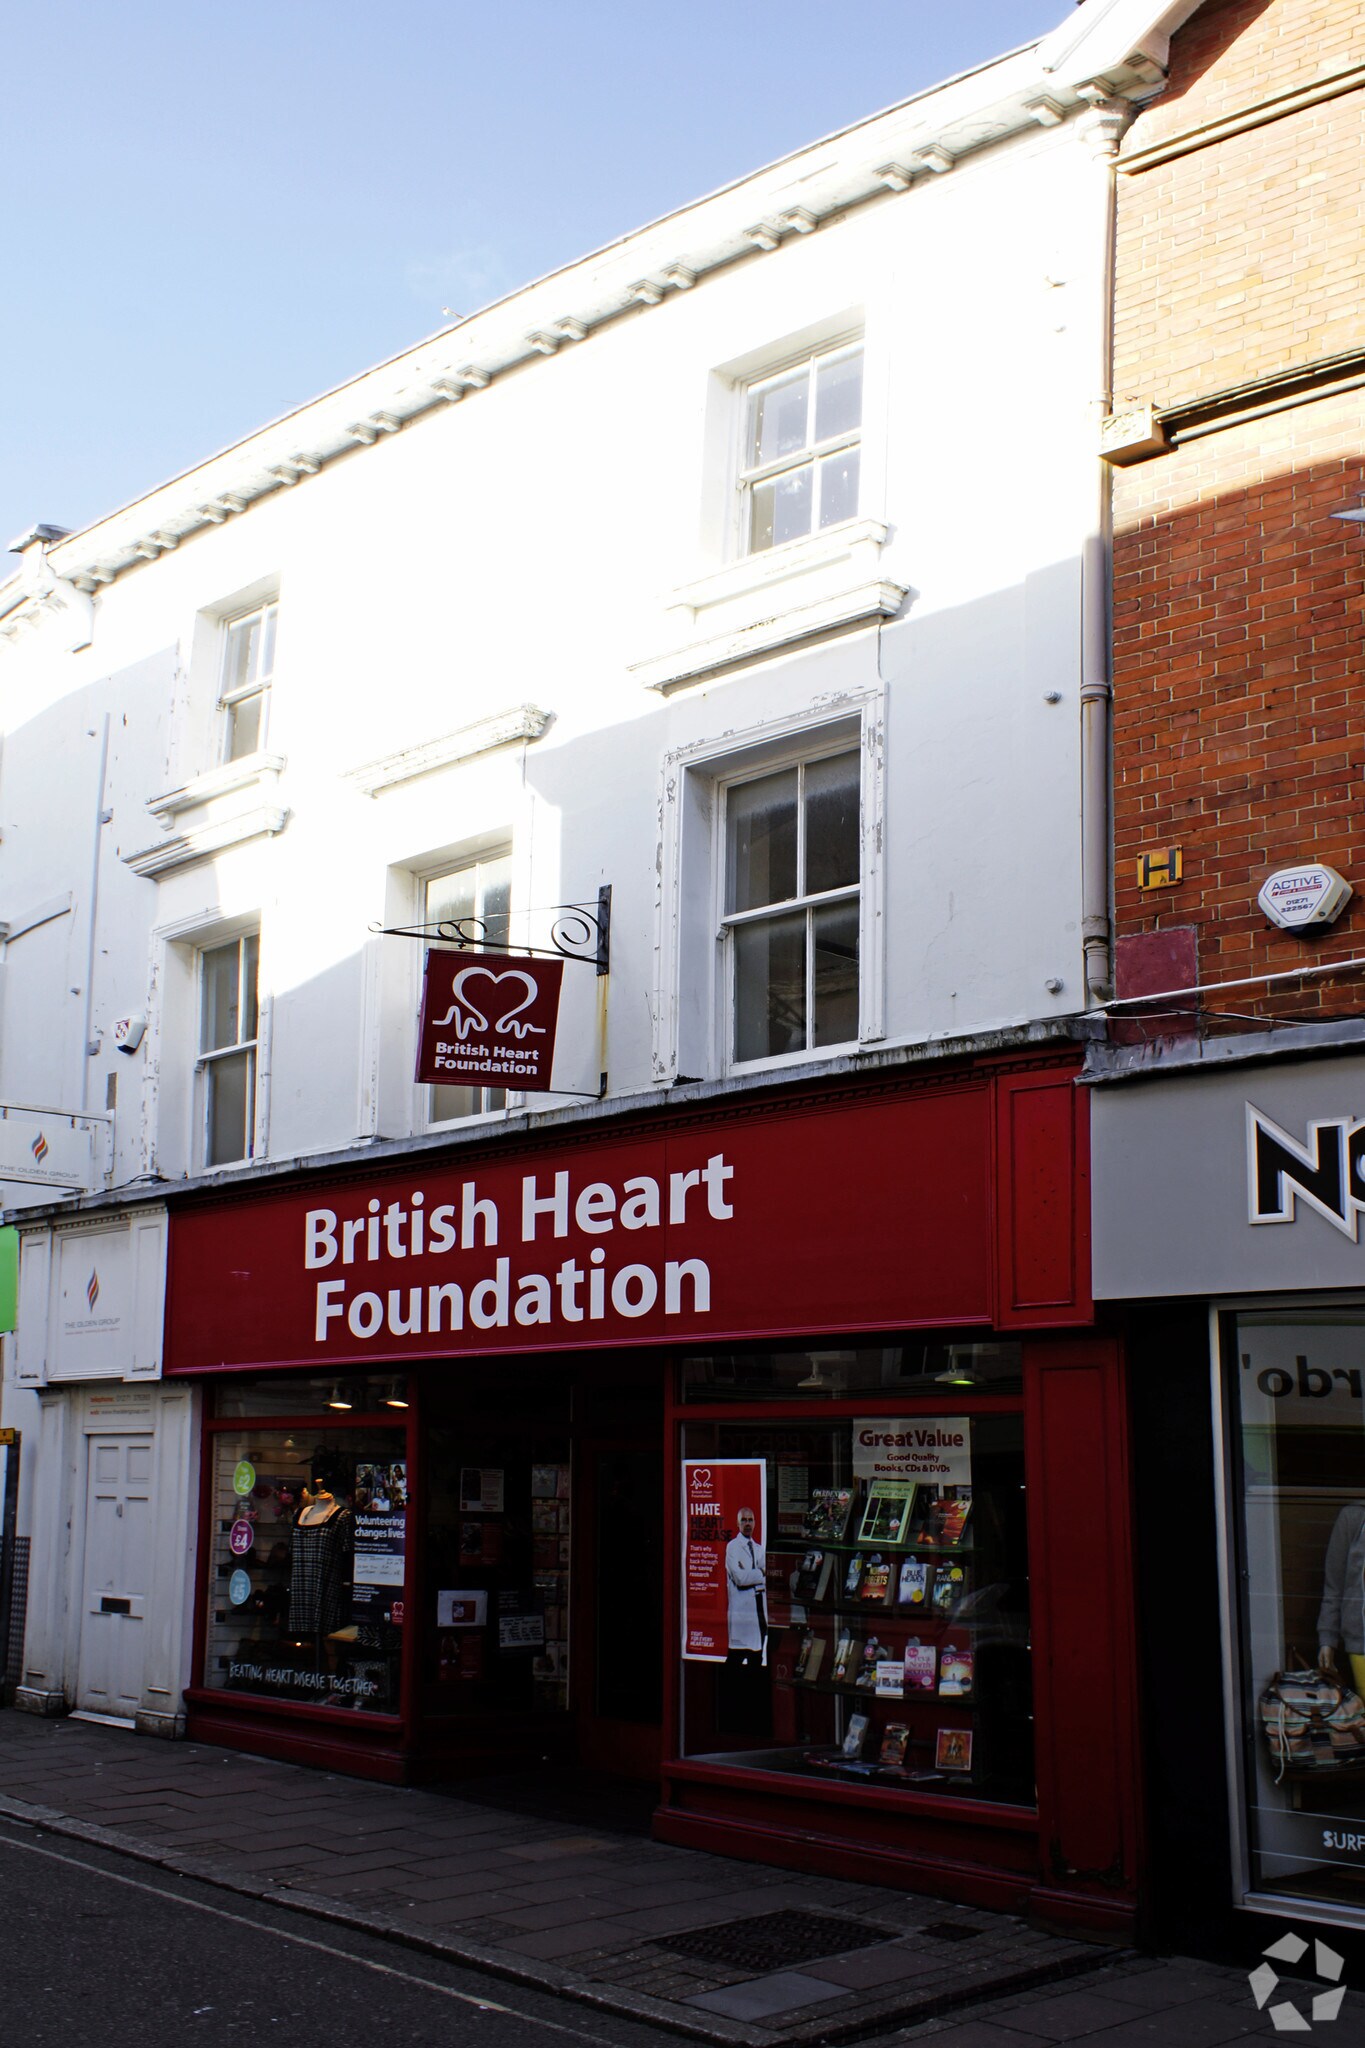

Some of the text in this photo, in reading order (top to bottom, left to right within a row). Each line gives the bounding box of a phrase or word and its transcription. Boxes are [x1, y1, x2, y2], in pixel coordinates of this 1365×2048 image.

[1143, 849, 1176, 886] H
[1271, 874, 1322, 892] ACTIVE
[1281, 903, 1314, 913] 322567
[1286, 897, 1308, 905] 01271
[435, 1042, 539, 1060] British Heart
[434, 1056, 538, 1075] Foundation
[18, 1167, 47, 1175] OLDEN
[49, 1171, 80, 1179] GROUP
[305, 1153, 734, 1269] British Heart
[315, 1247, 710, 1341] Foundation
[859, 1430, 913, 1447] Great
[915, 1430, 964, 1447] Value
[887, 1453, 940, 1463] Good Quality
[874, 1464, 904, 1473] Books,
[905, 1464, 921, 1473] CDs
[922, 1465, 929, 1473] &
[237, 1474, 251, 1490] £2
[690, 1503, 721, 1515] I HATE
[355, 1515, 405, 1529] Volunteering
[691, 1516, 724, 1528] HEART
[234, 1533, 248, 1550] £4
[354, 1527, 405, 1540] changes lives
[690, 1529, 733, 1541] DISEASE
[901, 1575, 925, 1583] HEAVEN
[233, 1584, 245, 1600] £5
[229, 1661, 376, 1696] BEATING HEART DISEASE TOGETHER
[1323, 1830, 1365, 1851] SURF
